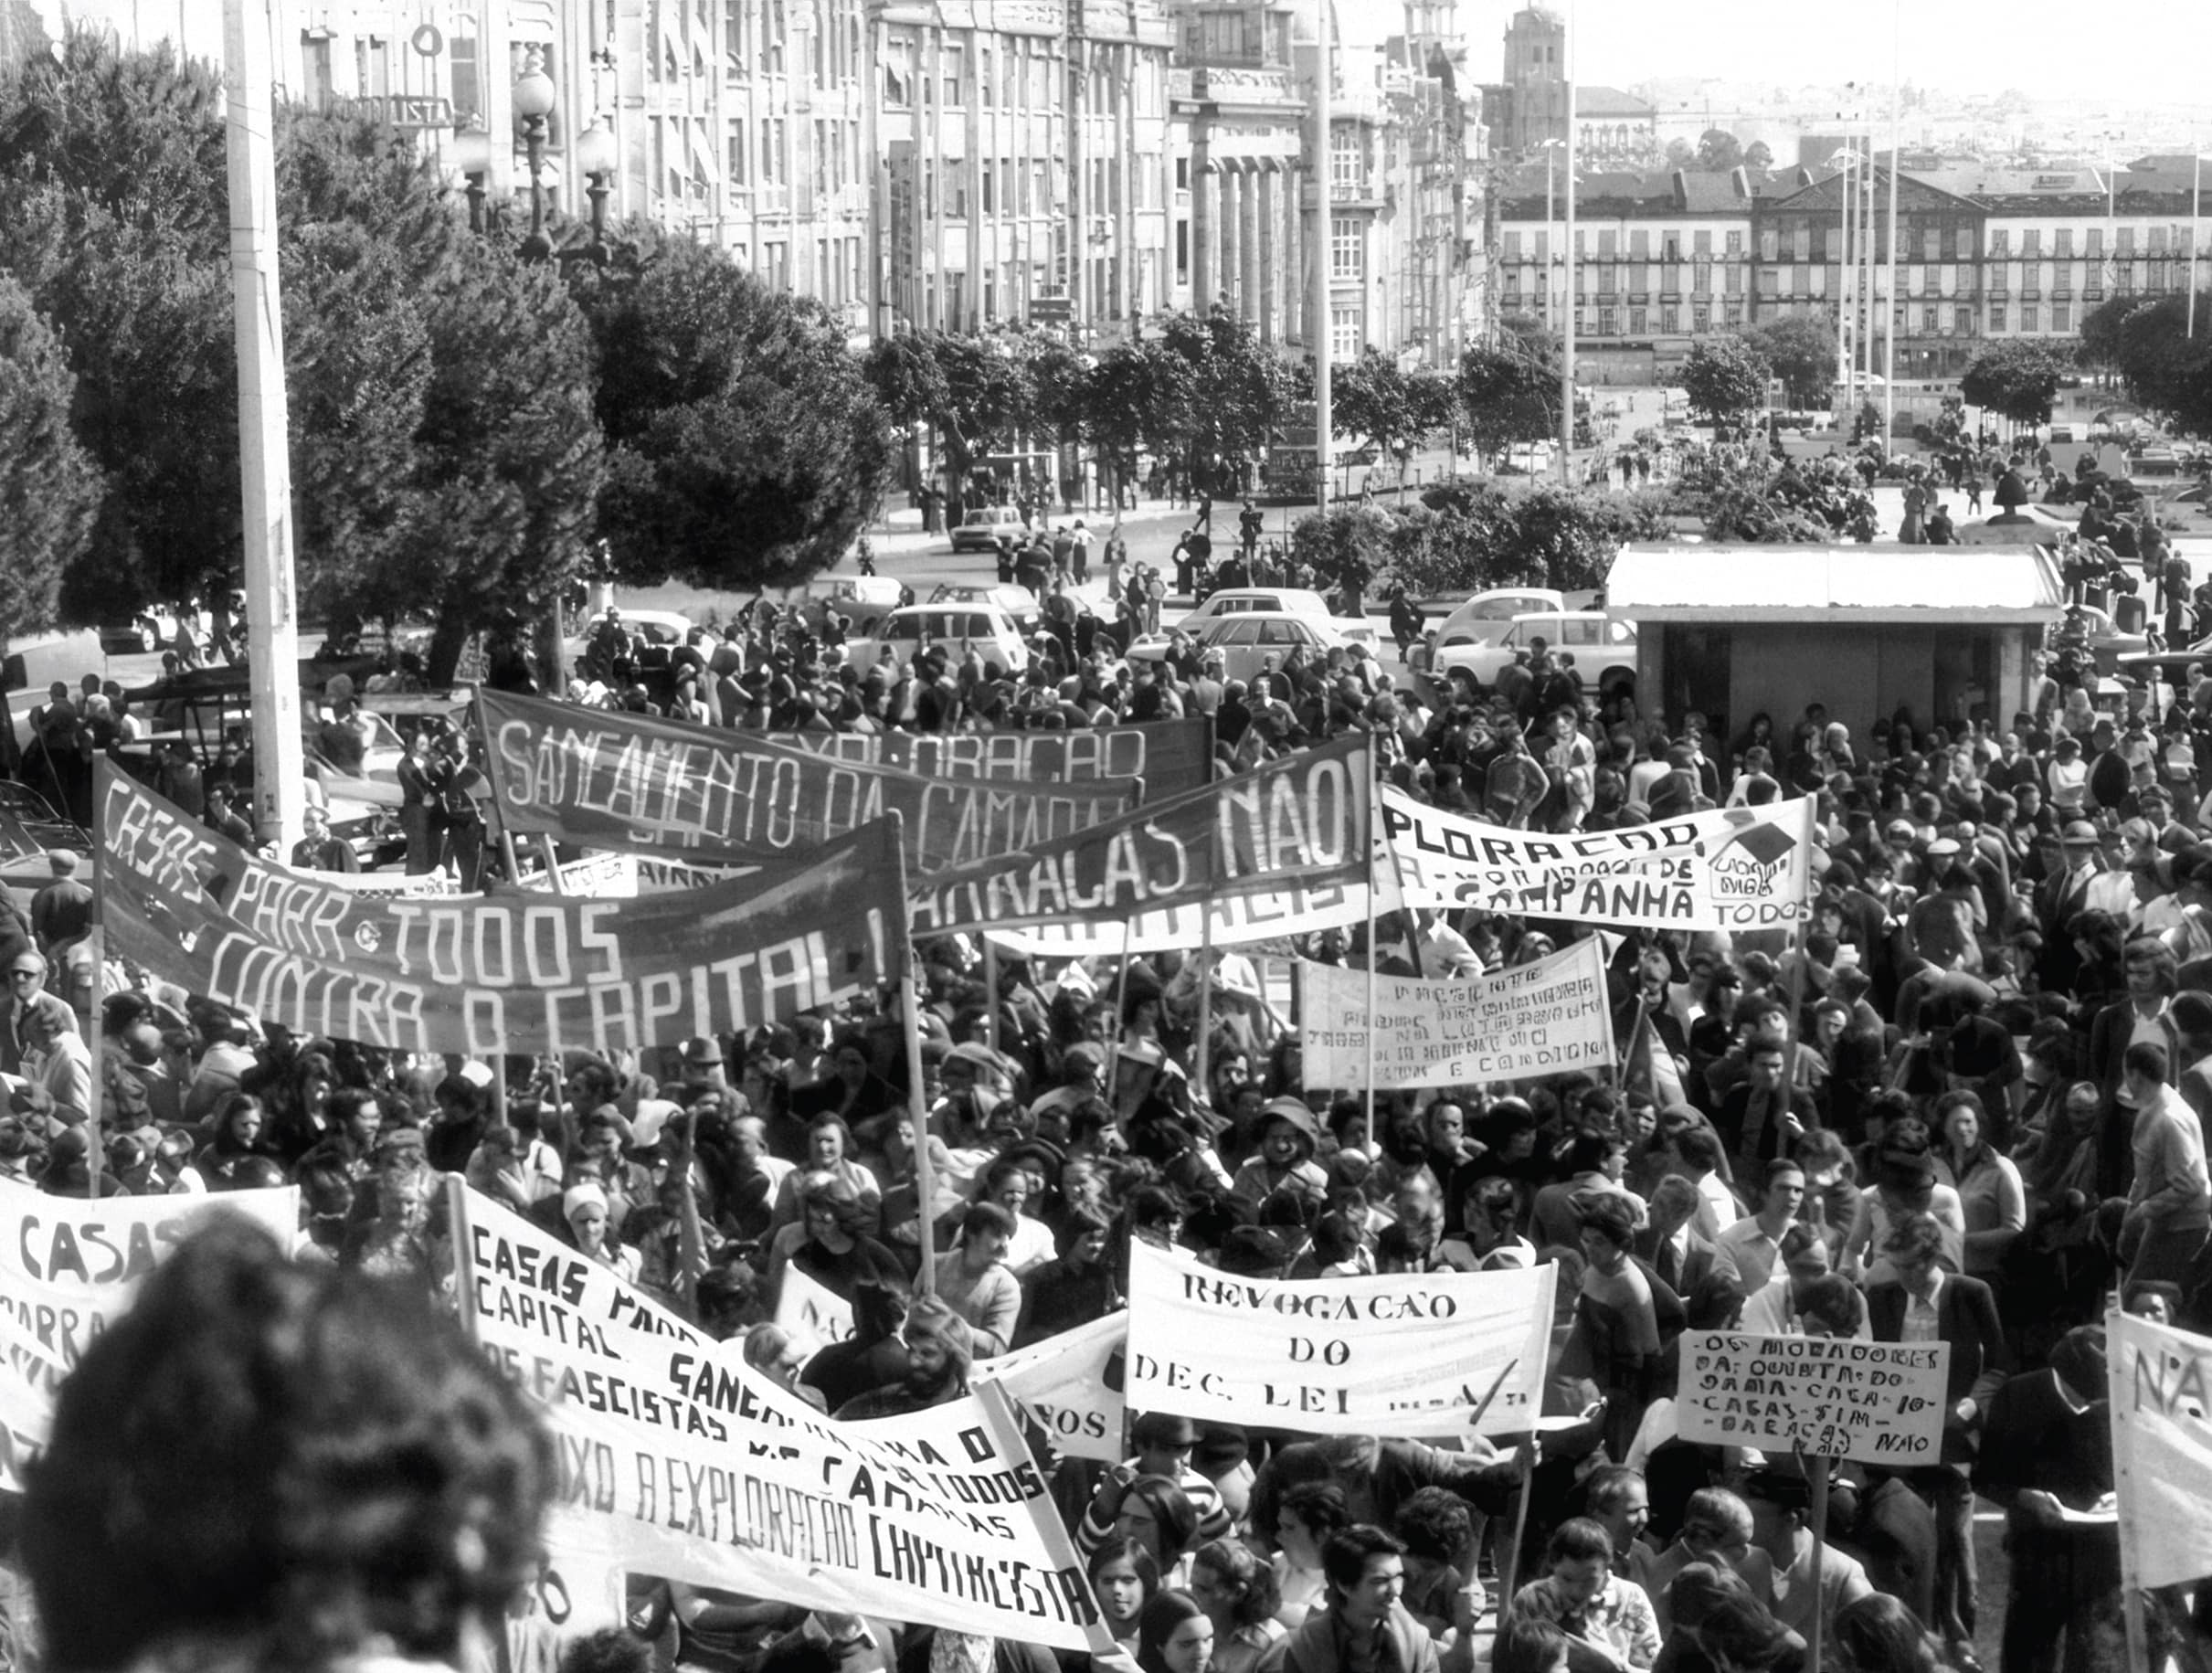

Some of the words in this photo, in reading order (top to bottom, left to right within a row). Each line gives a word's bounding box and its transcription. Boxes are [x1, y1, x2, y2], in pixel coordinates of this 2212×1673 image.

[228, 866, 353, 961] PARA
[388, 903, 623, 987] TODOS
[464, 990, 507, 1054] O
[471, 1223, 589, 1307] CASAS
[1135, 1353, 1233, 1402] DEC.
[1264, 1383, 1350, 1414] LEI
[1287, 1337, 1351, 1367] DO
[533, 1355, 729, 1444] FASCISTAS
